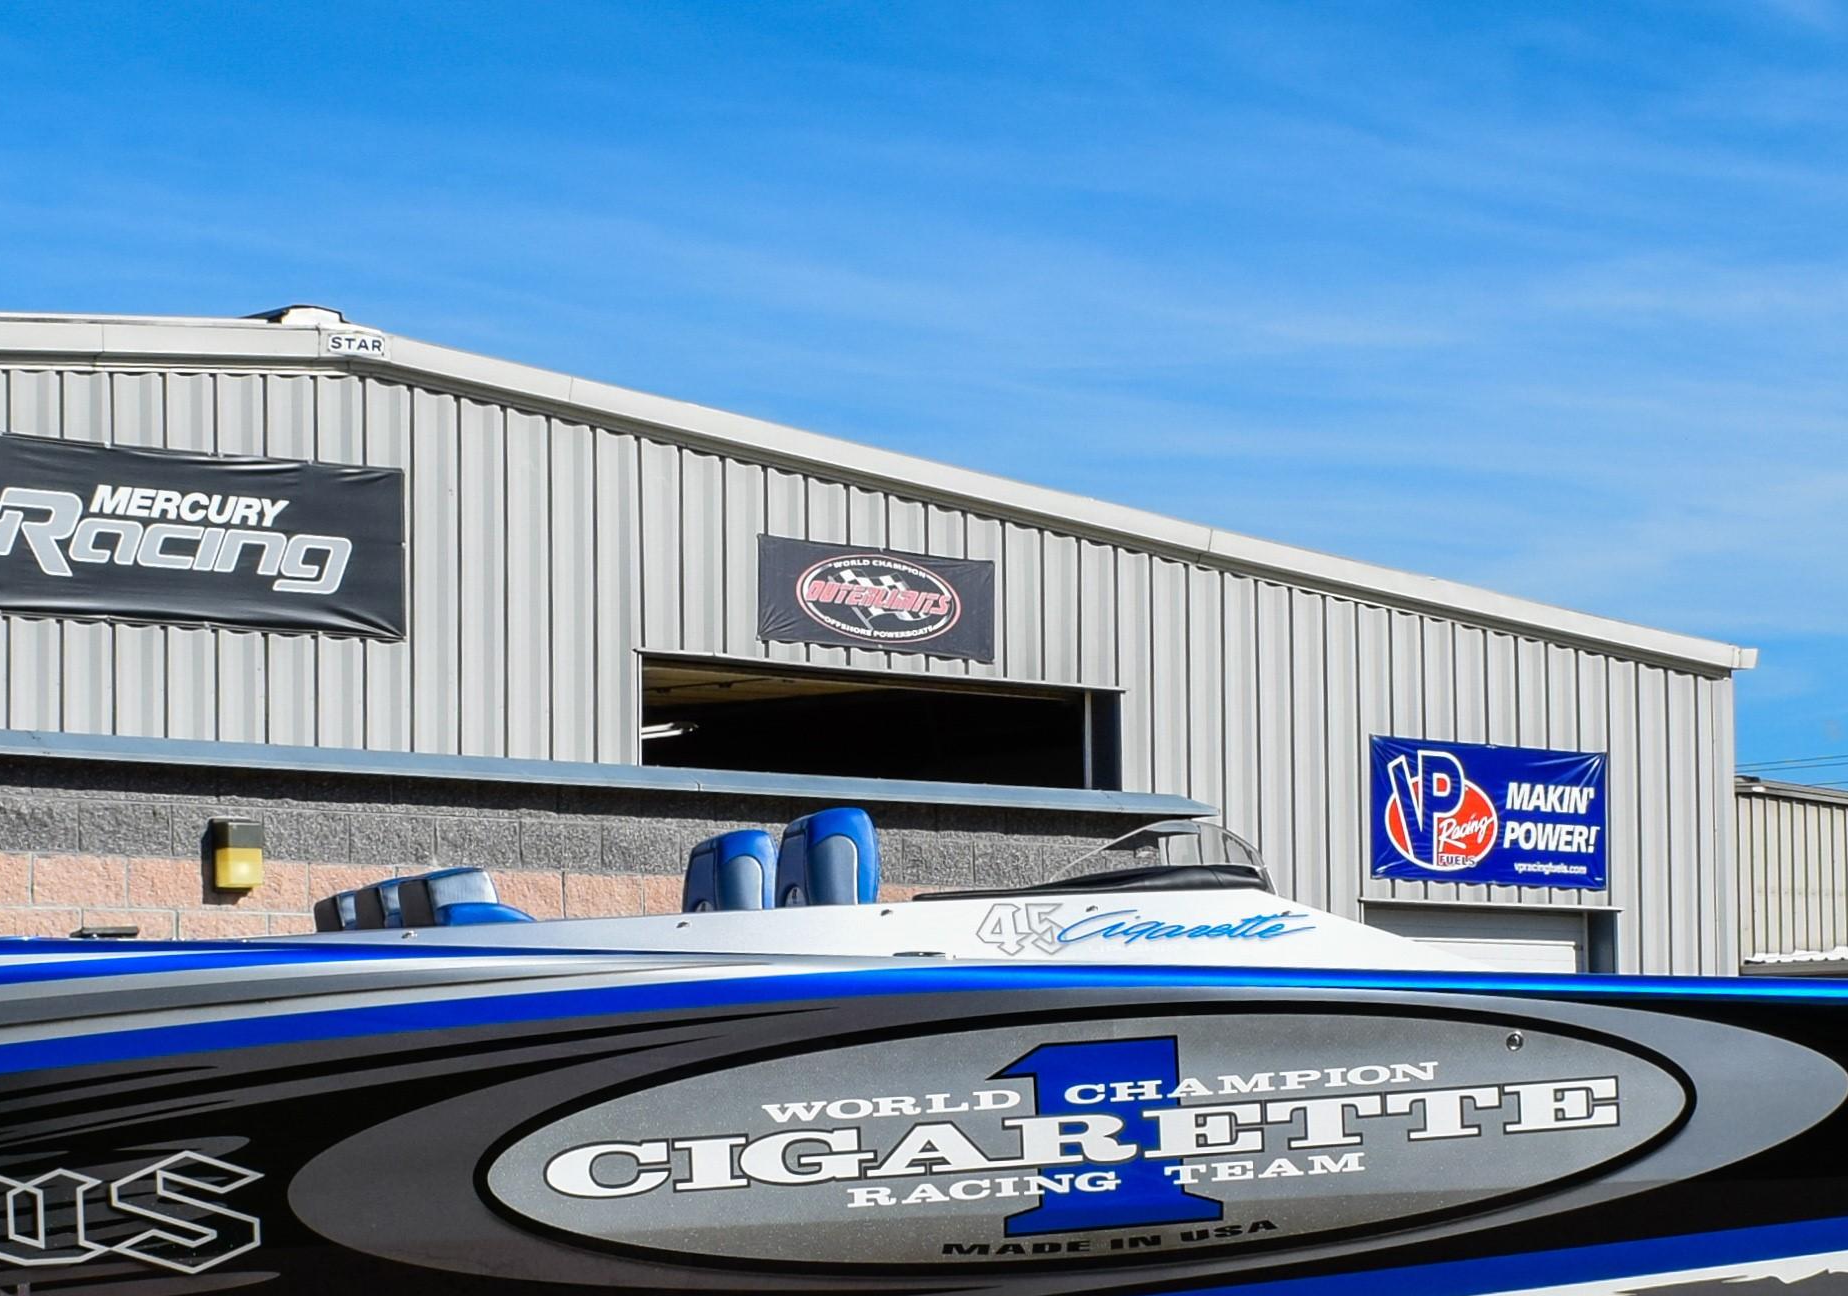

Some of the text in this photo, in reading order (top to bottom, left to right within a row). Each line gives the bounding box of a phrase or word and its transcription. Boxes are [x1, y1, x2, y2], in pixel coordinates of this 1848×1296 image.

[330, 336, 383, 352] STAR
[89, 484, 290, 527] MERCURY
[833, 559, 926, 579] WORLD CHAMPION
[824, 616, 872, 636] OFFSHORE
[1387, 750, 1466, 867] VP
[1505, 782, 1595, 814] MAKIN'
[1438, 814, 1495, 852] Racing
[1503, 821, 1601, 853] POWER!
[1439, 854, 1477, 866] FUELS
[976, 903, 1316, 955] 45 Cigarette
[761, 1061, 1439, 1124] WORLD CHAMPION
[545, 1076, 1621, 1200] CIGARETTE
[846, 1152, 1365, 1208] RACING TEAM
[941, 1219, 1279, 1257] MADE IN USA
